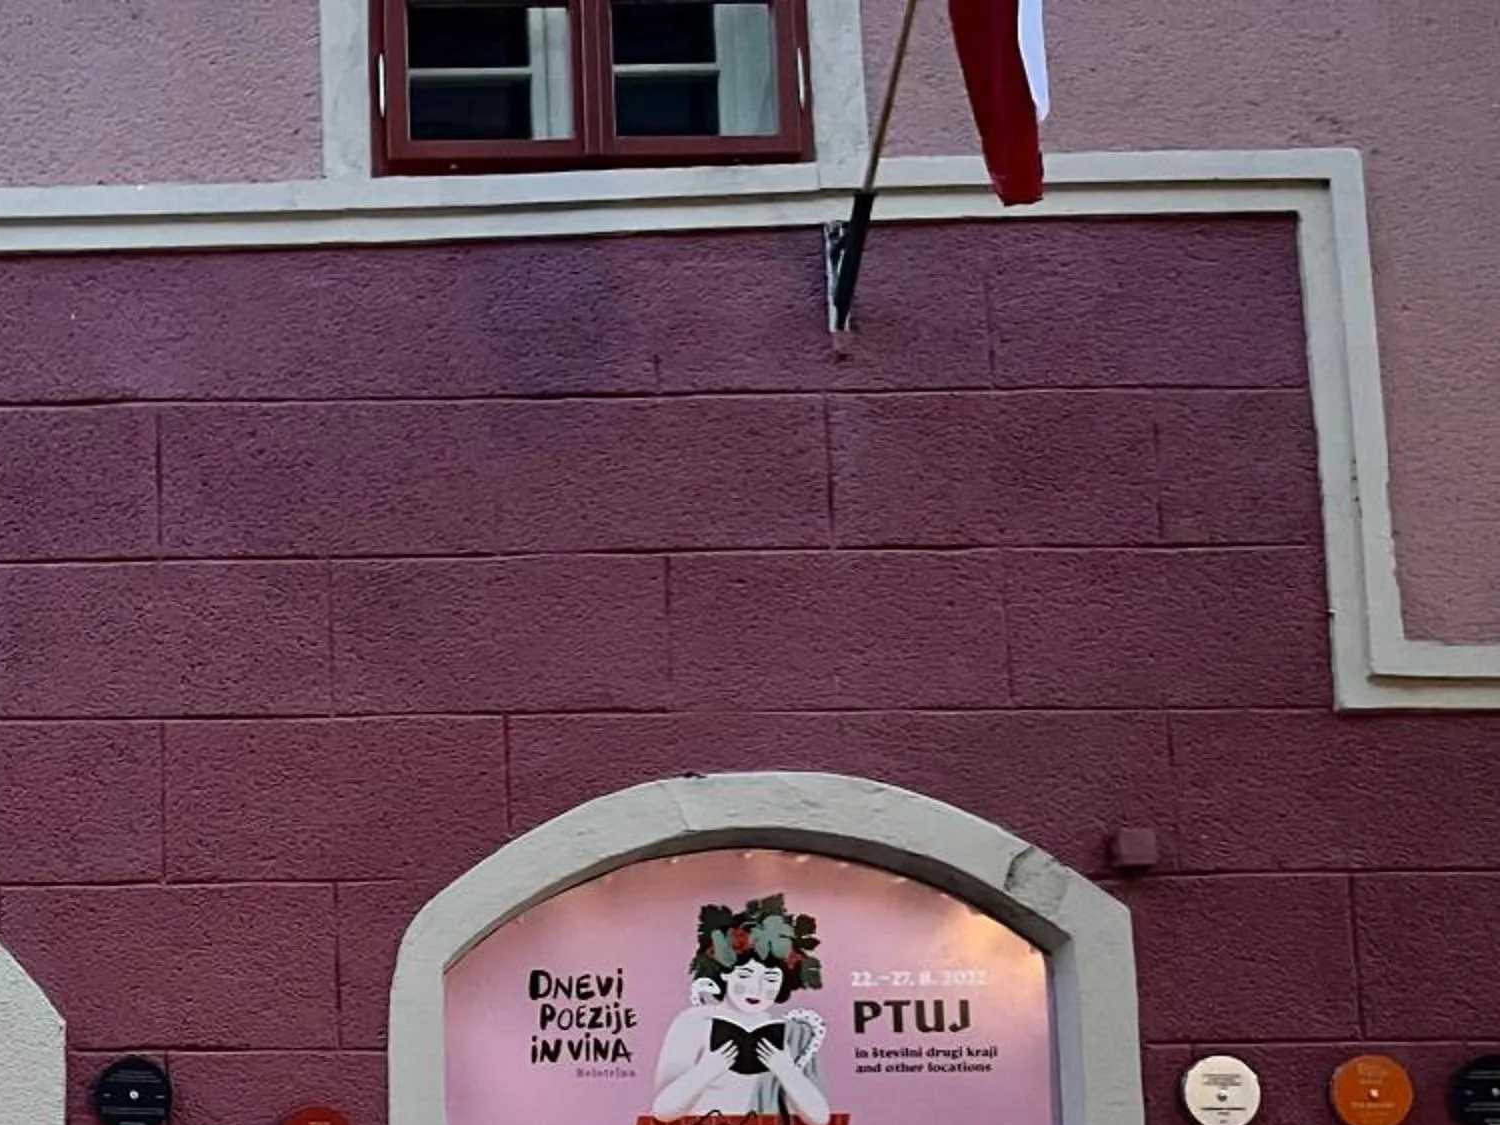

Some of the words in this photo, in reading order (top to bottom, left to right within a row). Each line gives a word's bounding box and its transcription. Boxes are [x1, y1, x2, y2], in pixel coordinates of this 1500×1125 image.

[854, 999, 971, 1034] PTUJ
[854, 1048, 868, 1059] in
[872, 1047, 923, 1059] številni
[926, 1047, 962, 1060] drugi
[966, 1046, 998, 1059] kraji
[855, 1063, 881, 1073] and
[885, 1063, 923, 1073] other
[928, 1062, 992, 1072] locations
